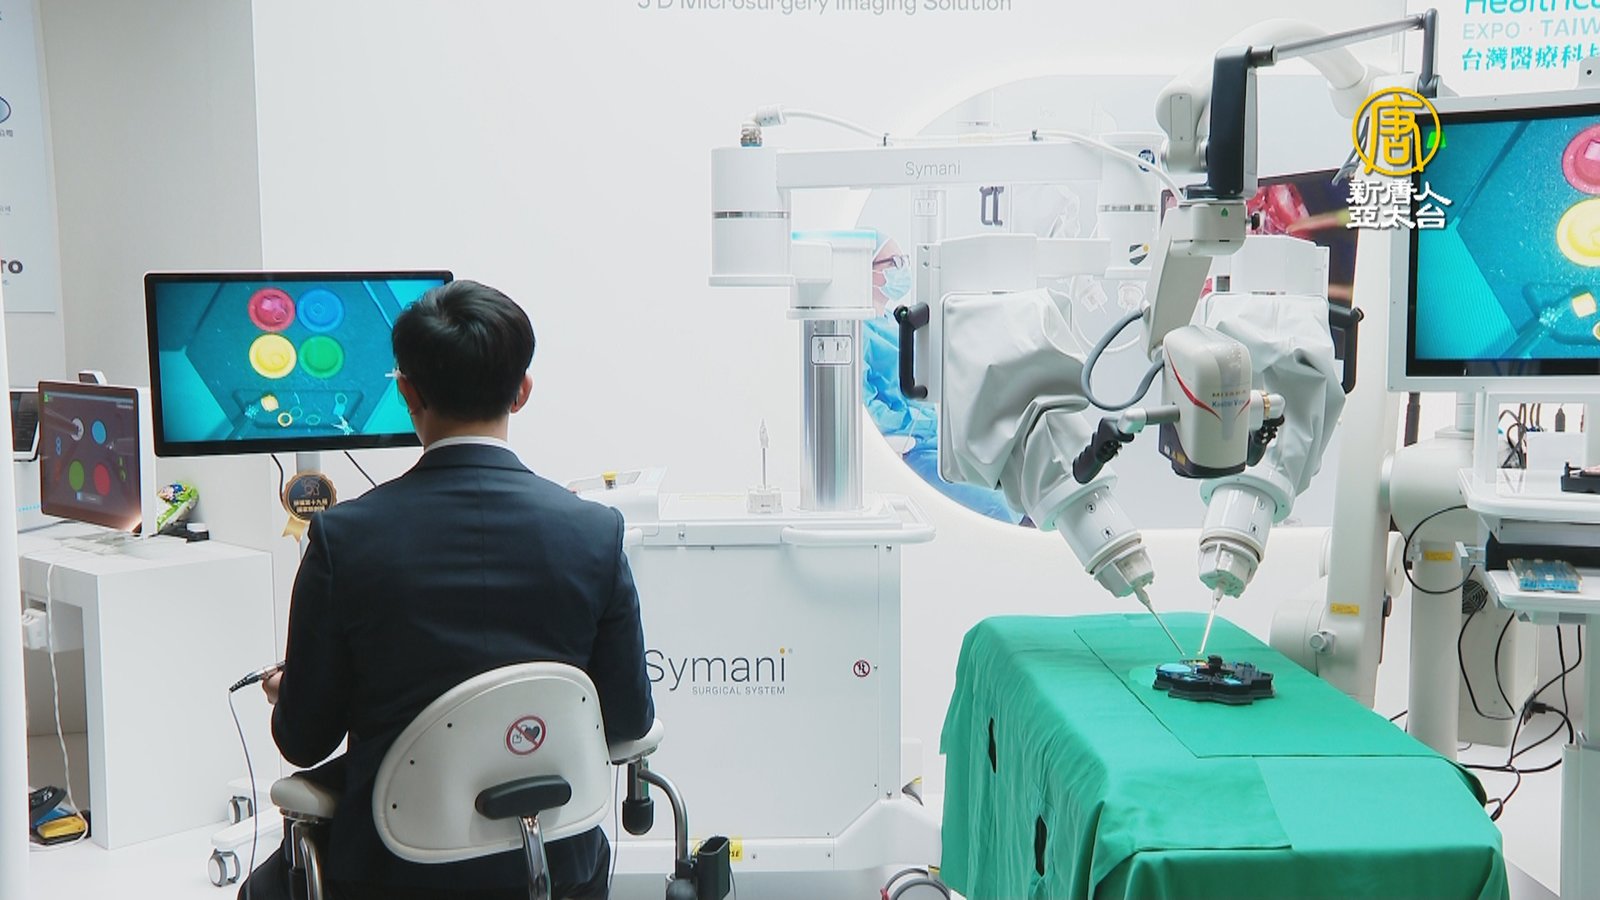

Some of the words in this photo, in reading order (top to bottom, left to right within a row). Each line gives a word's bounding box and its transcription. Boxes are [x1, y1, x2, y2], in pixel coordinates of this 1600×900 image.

[681, 0, 829, 15] Microsurgery
[836, 0, 917, 16] Imaging
[923, 0, 1012, 11] Solution
[1463, 21, 1521, 40] EXPO
[904, 159, 961, 180] Symani
[644, 648, 786, 691] Symani
[692, 685, 741, 696] SURGICAL
[745, 685, 785, 696] SYSTEM
